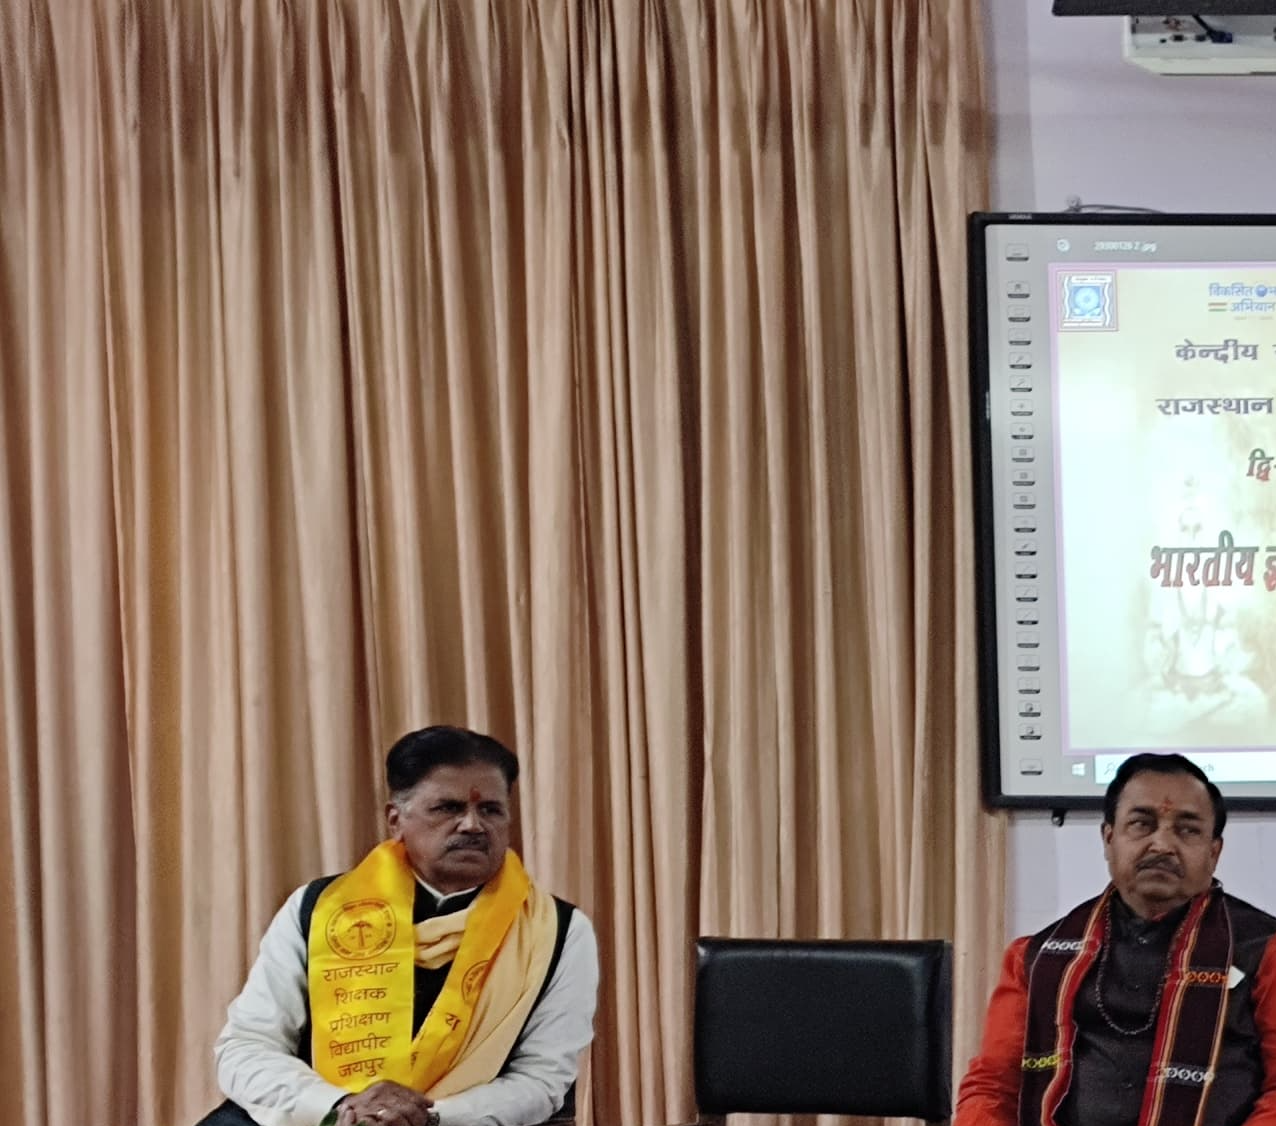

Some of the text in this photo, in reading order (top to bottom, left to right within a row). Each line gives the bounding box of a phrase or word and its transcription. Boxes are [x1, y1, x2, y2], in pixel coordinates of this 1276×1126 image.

[1156, 395, 1273, 417] राजस्थान
[1149, 531, 1258, 588] भारतीय
[322, 962, 400, 981] राजस्थान
[334, 987, 388, 1005] शिक्षक
[329, 1012, 392, 1032] प्रशिक्षण
[338, 1057, 386, 1077] जयपुर
